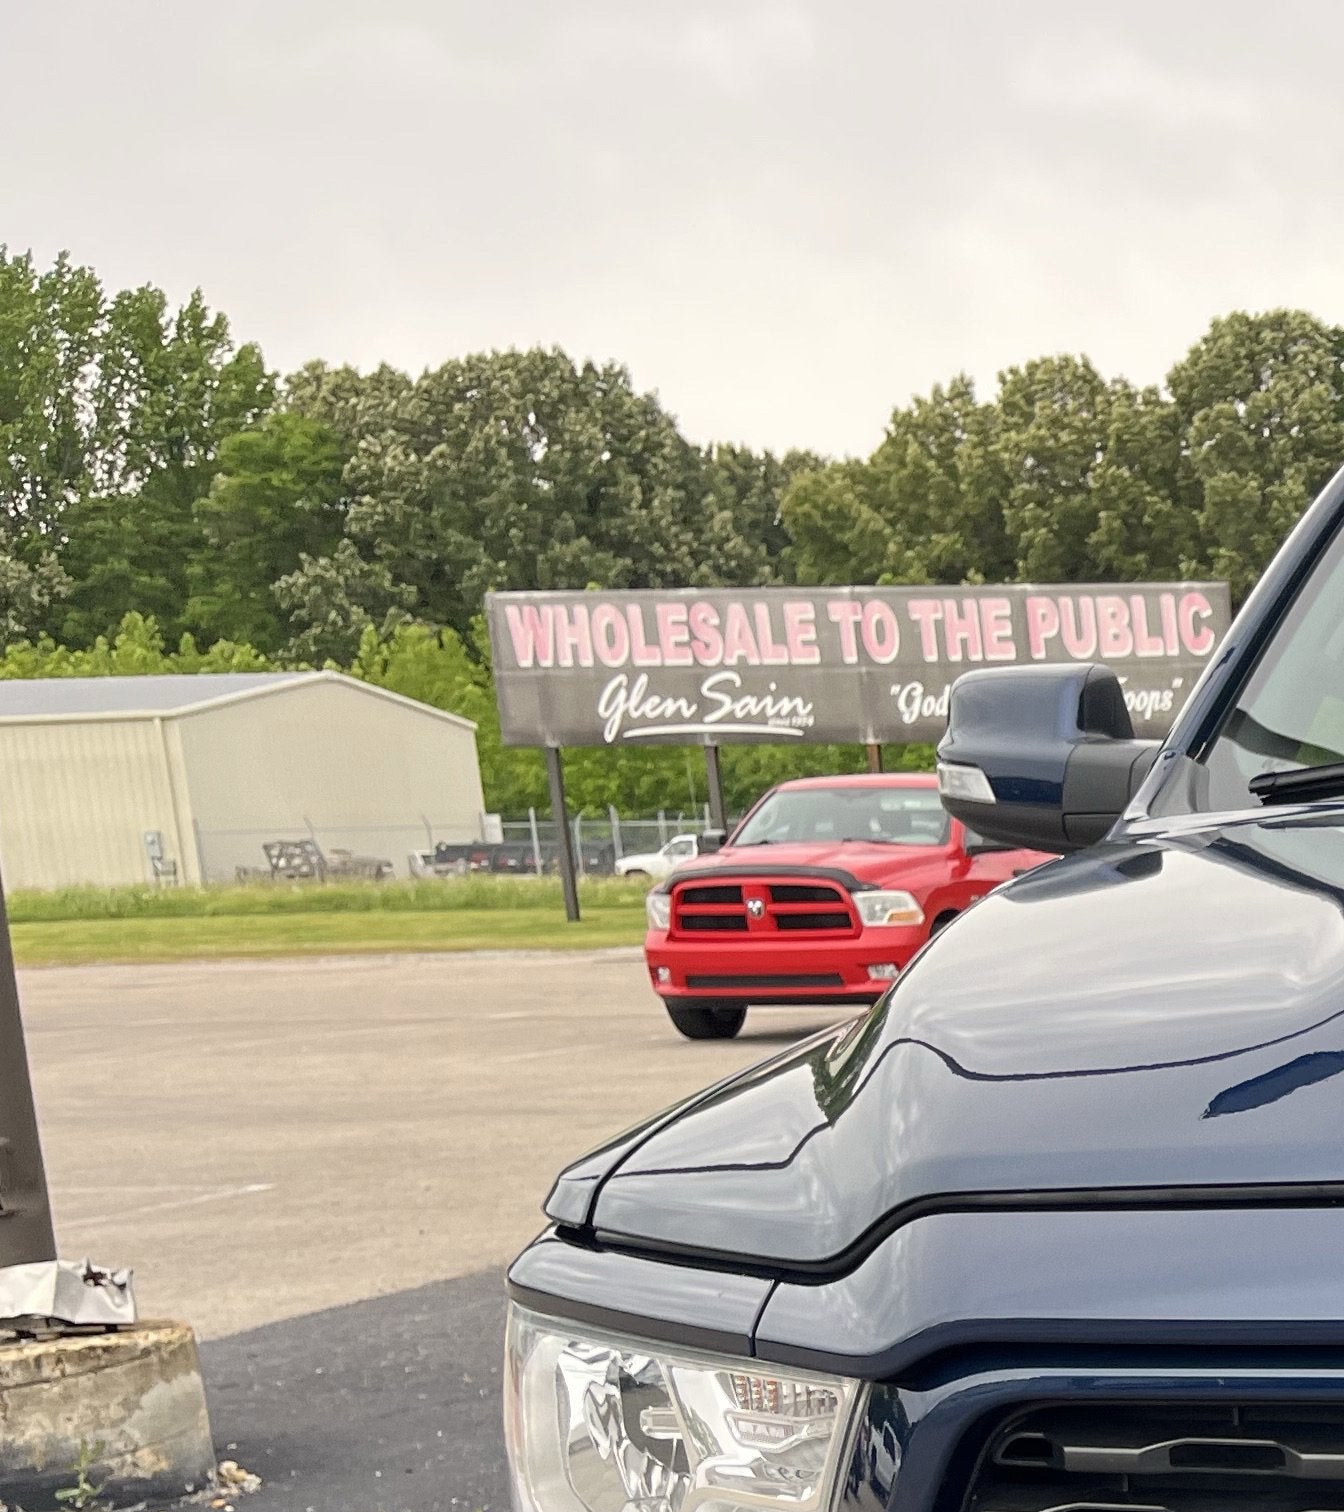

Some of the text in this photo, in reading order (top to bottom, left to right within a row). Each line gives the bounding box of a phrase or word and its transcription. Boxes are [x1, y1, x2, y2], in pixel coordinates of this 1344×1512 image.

[504, 592, 1215, 668] WHOLESALE TO THE PUBLIC
[598, 671, 813, 743] Glen Sain
